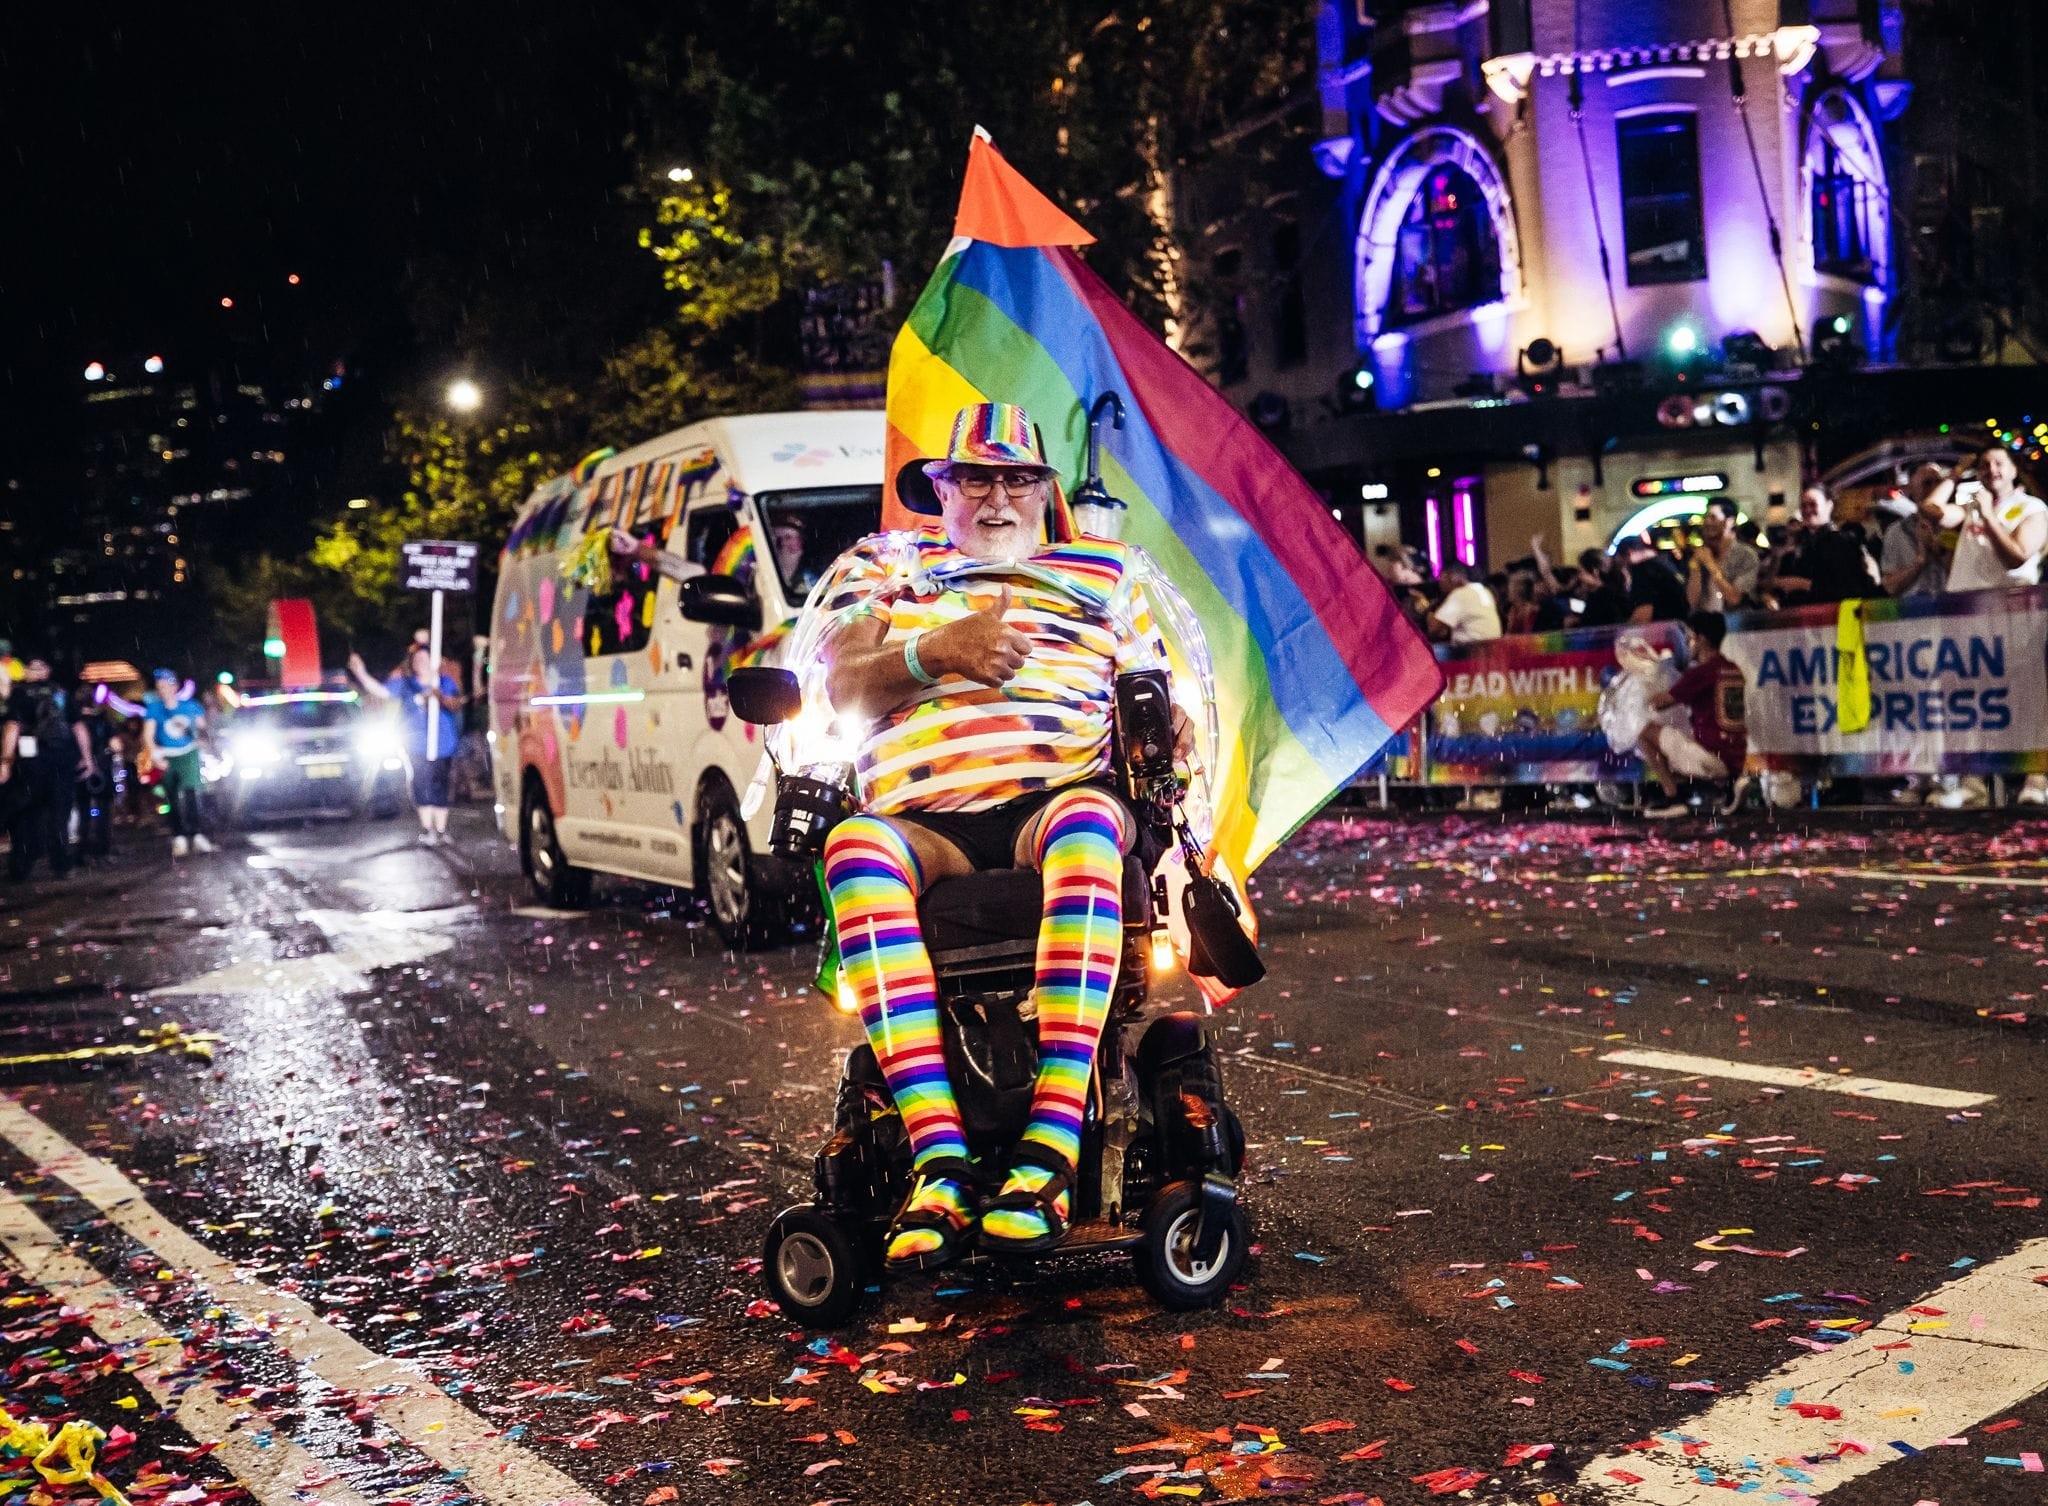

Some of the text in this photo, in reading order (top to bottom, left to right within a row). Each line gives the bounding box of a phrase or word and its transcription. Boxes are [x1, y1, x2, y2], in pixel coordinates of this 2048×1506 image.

[1756, 634, 2006, 688] AMRICAN
[1445, 671, 1507, 700] LEAD
[1509, 667, 1578, 696] WITH
